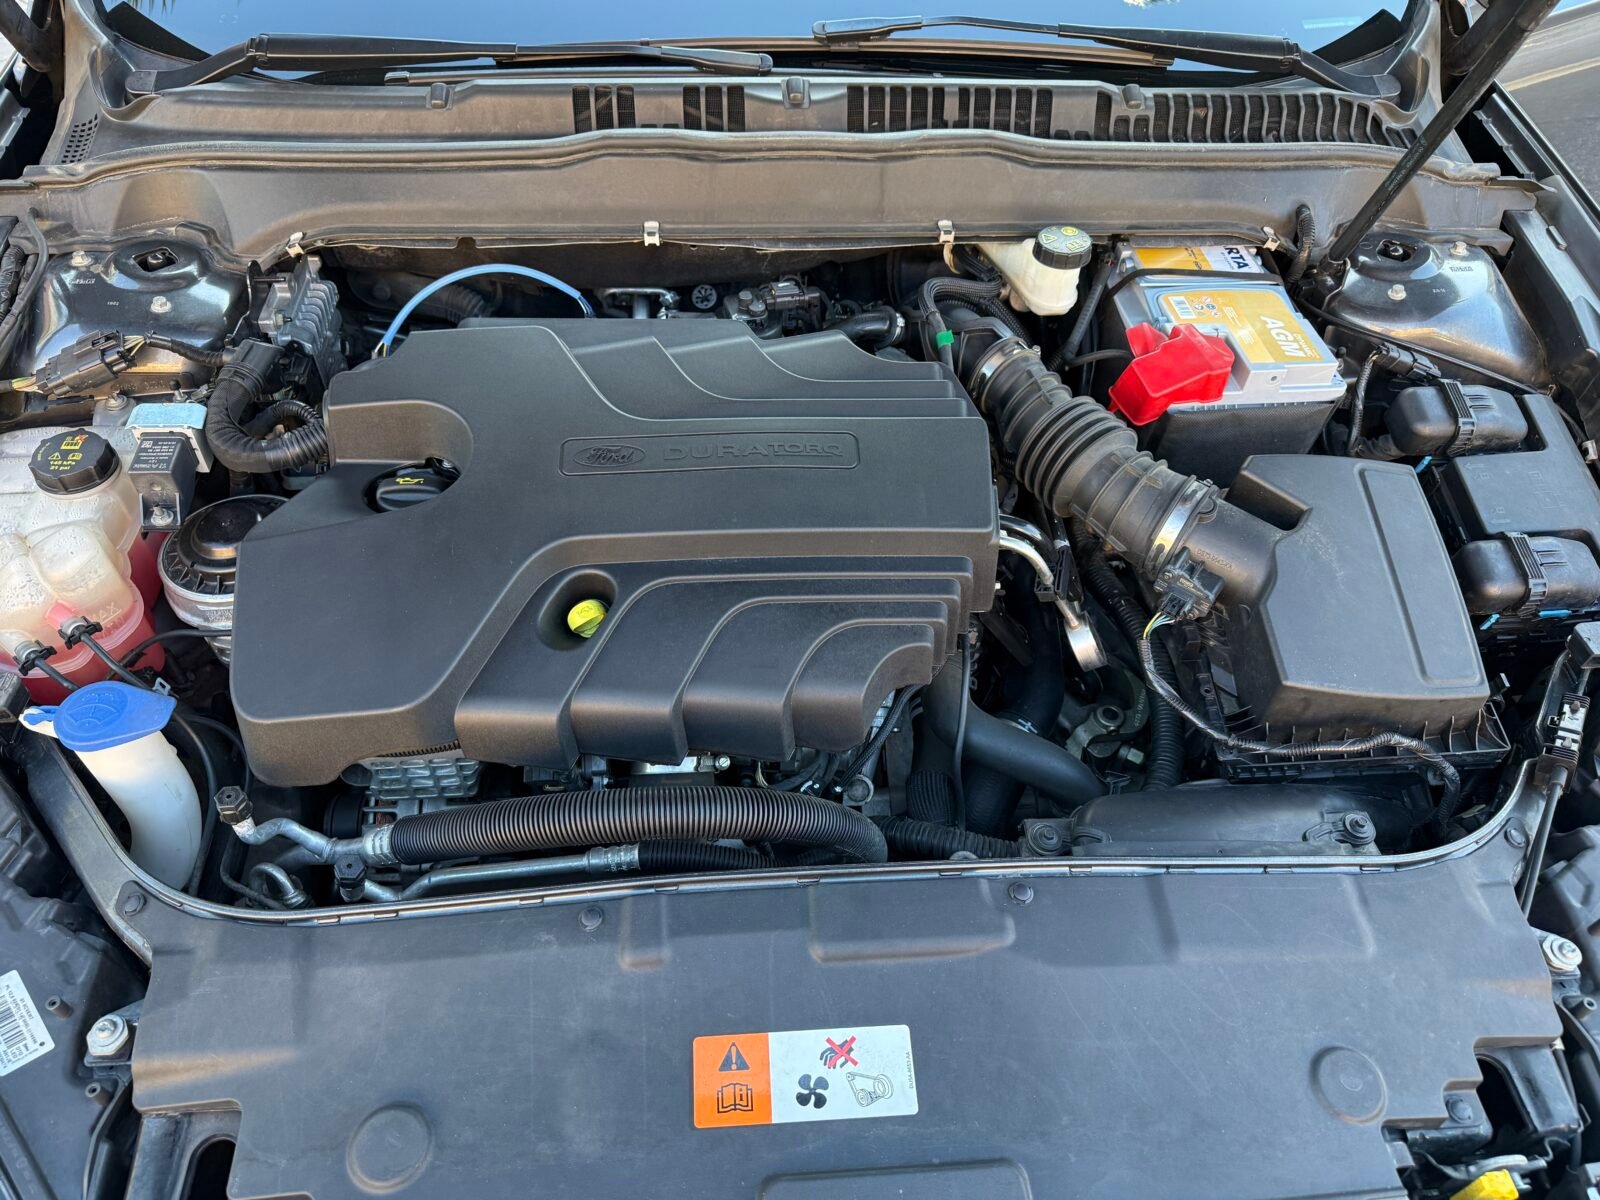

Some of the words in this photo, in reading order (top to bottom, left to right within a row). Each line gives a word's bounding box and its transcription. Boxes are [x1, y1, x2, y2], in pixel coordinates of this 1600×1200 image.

[1223, 246, 1249, 269] RTA
[1259, 315, 1307, 357] AGM
[583, 445, 637, 464] Ford
[663, 443, 843, 460] DURATORQ
